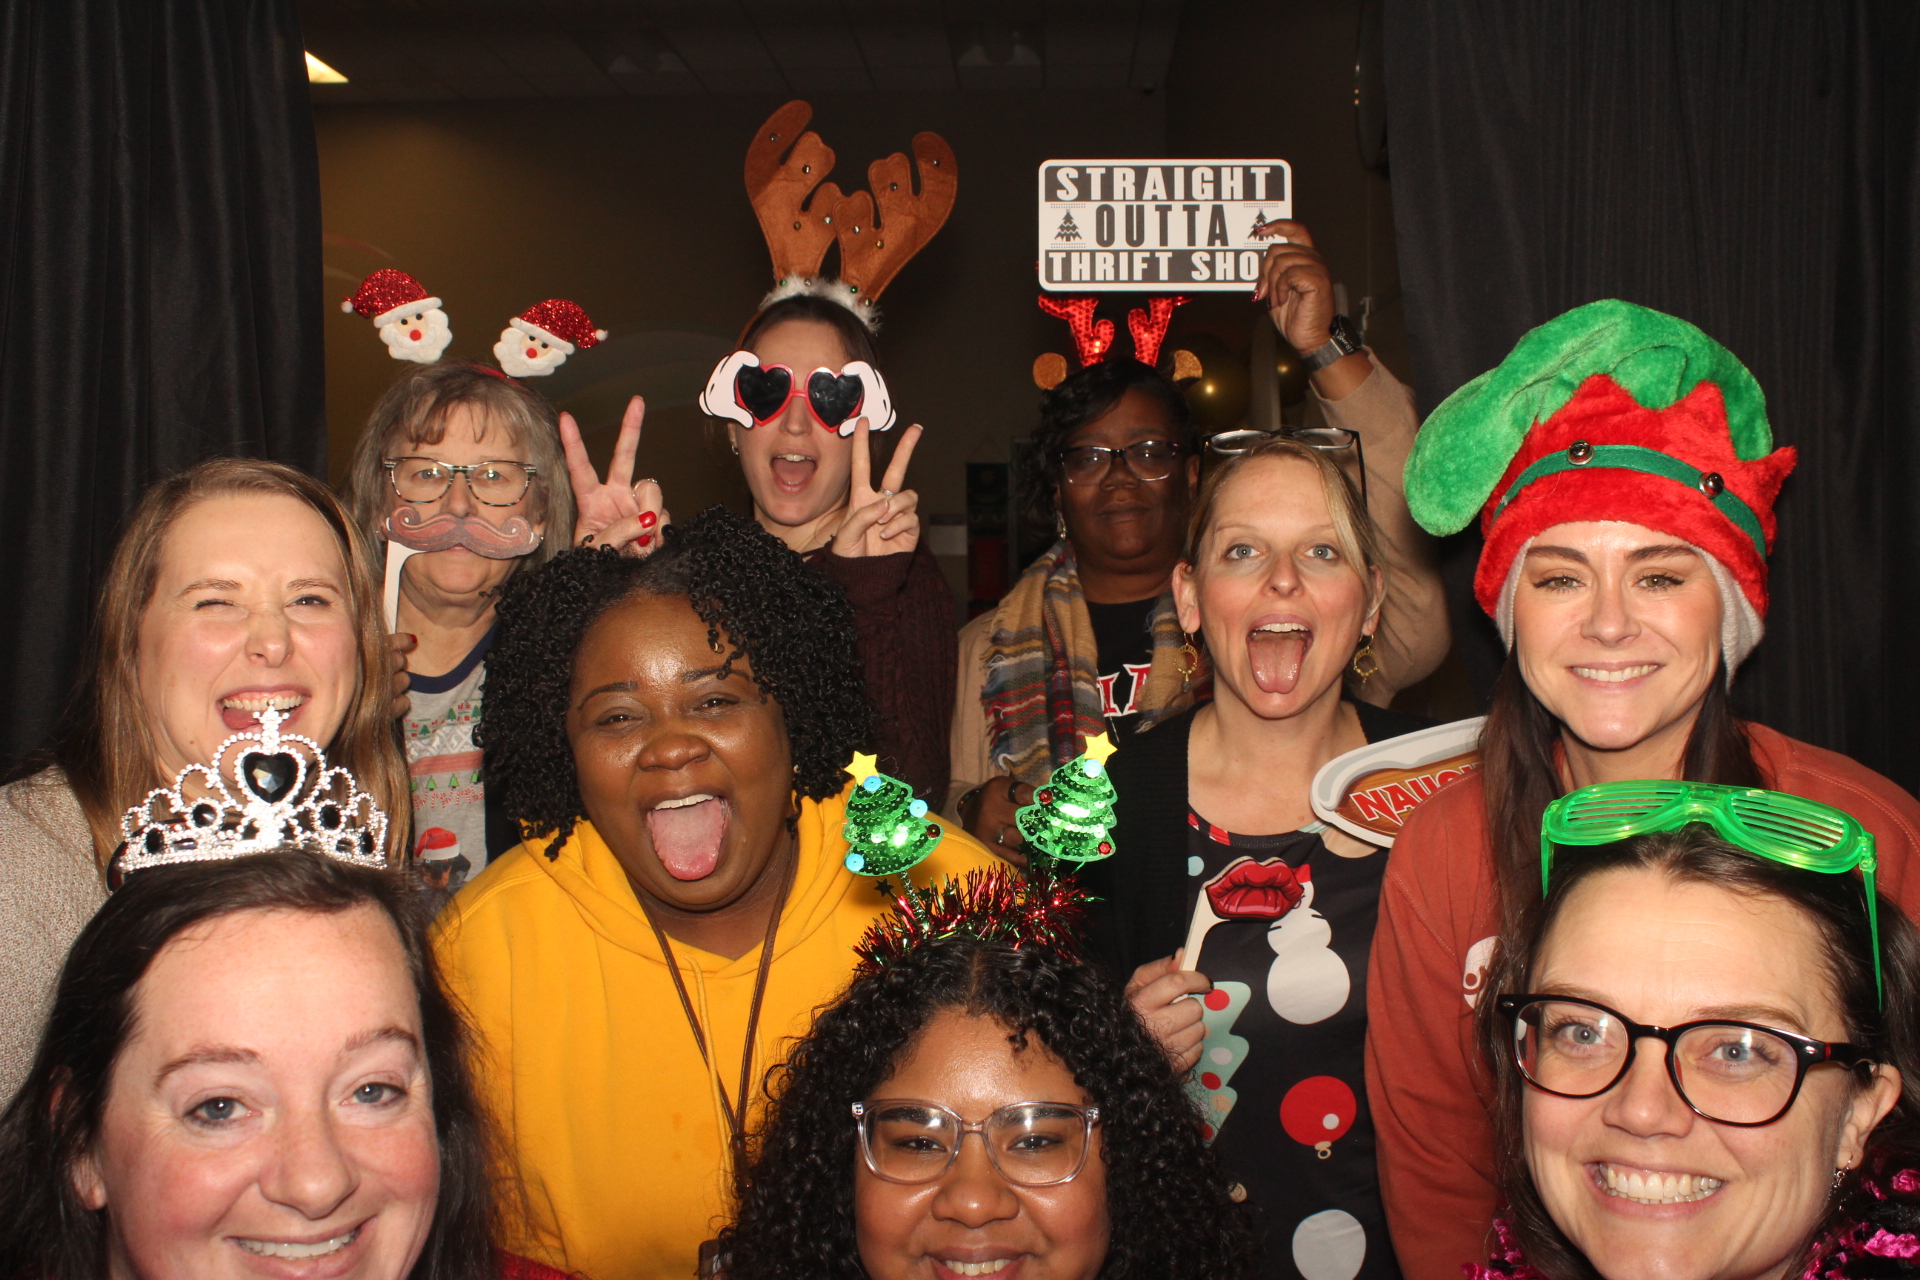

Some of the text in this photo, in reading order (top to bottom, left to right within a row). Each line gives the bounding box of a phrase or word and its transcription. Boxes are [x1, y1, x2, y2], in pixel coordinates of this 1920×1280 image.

[1056, 166, 1271, 201] STRAIGHT
[1095, 203, 1229, 248] OUTTA
[1049, 250, 1267, 281] THRIFT SHO
[1349, 763, 1483, 827] NAU
